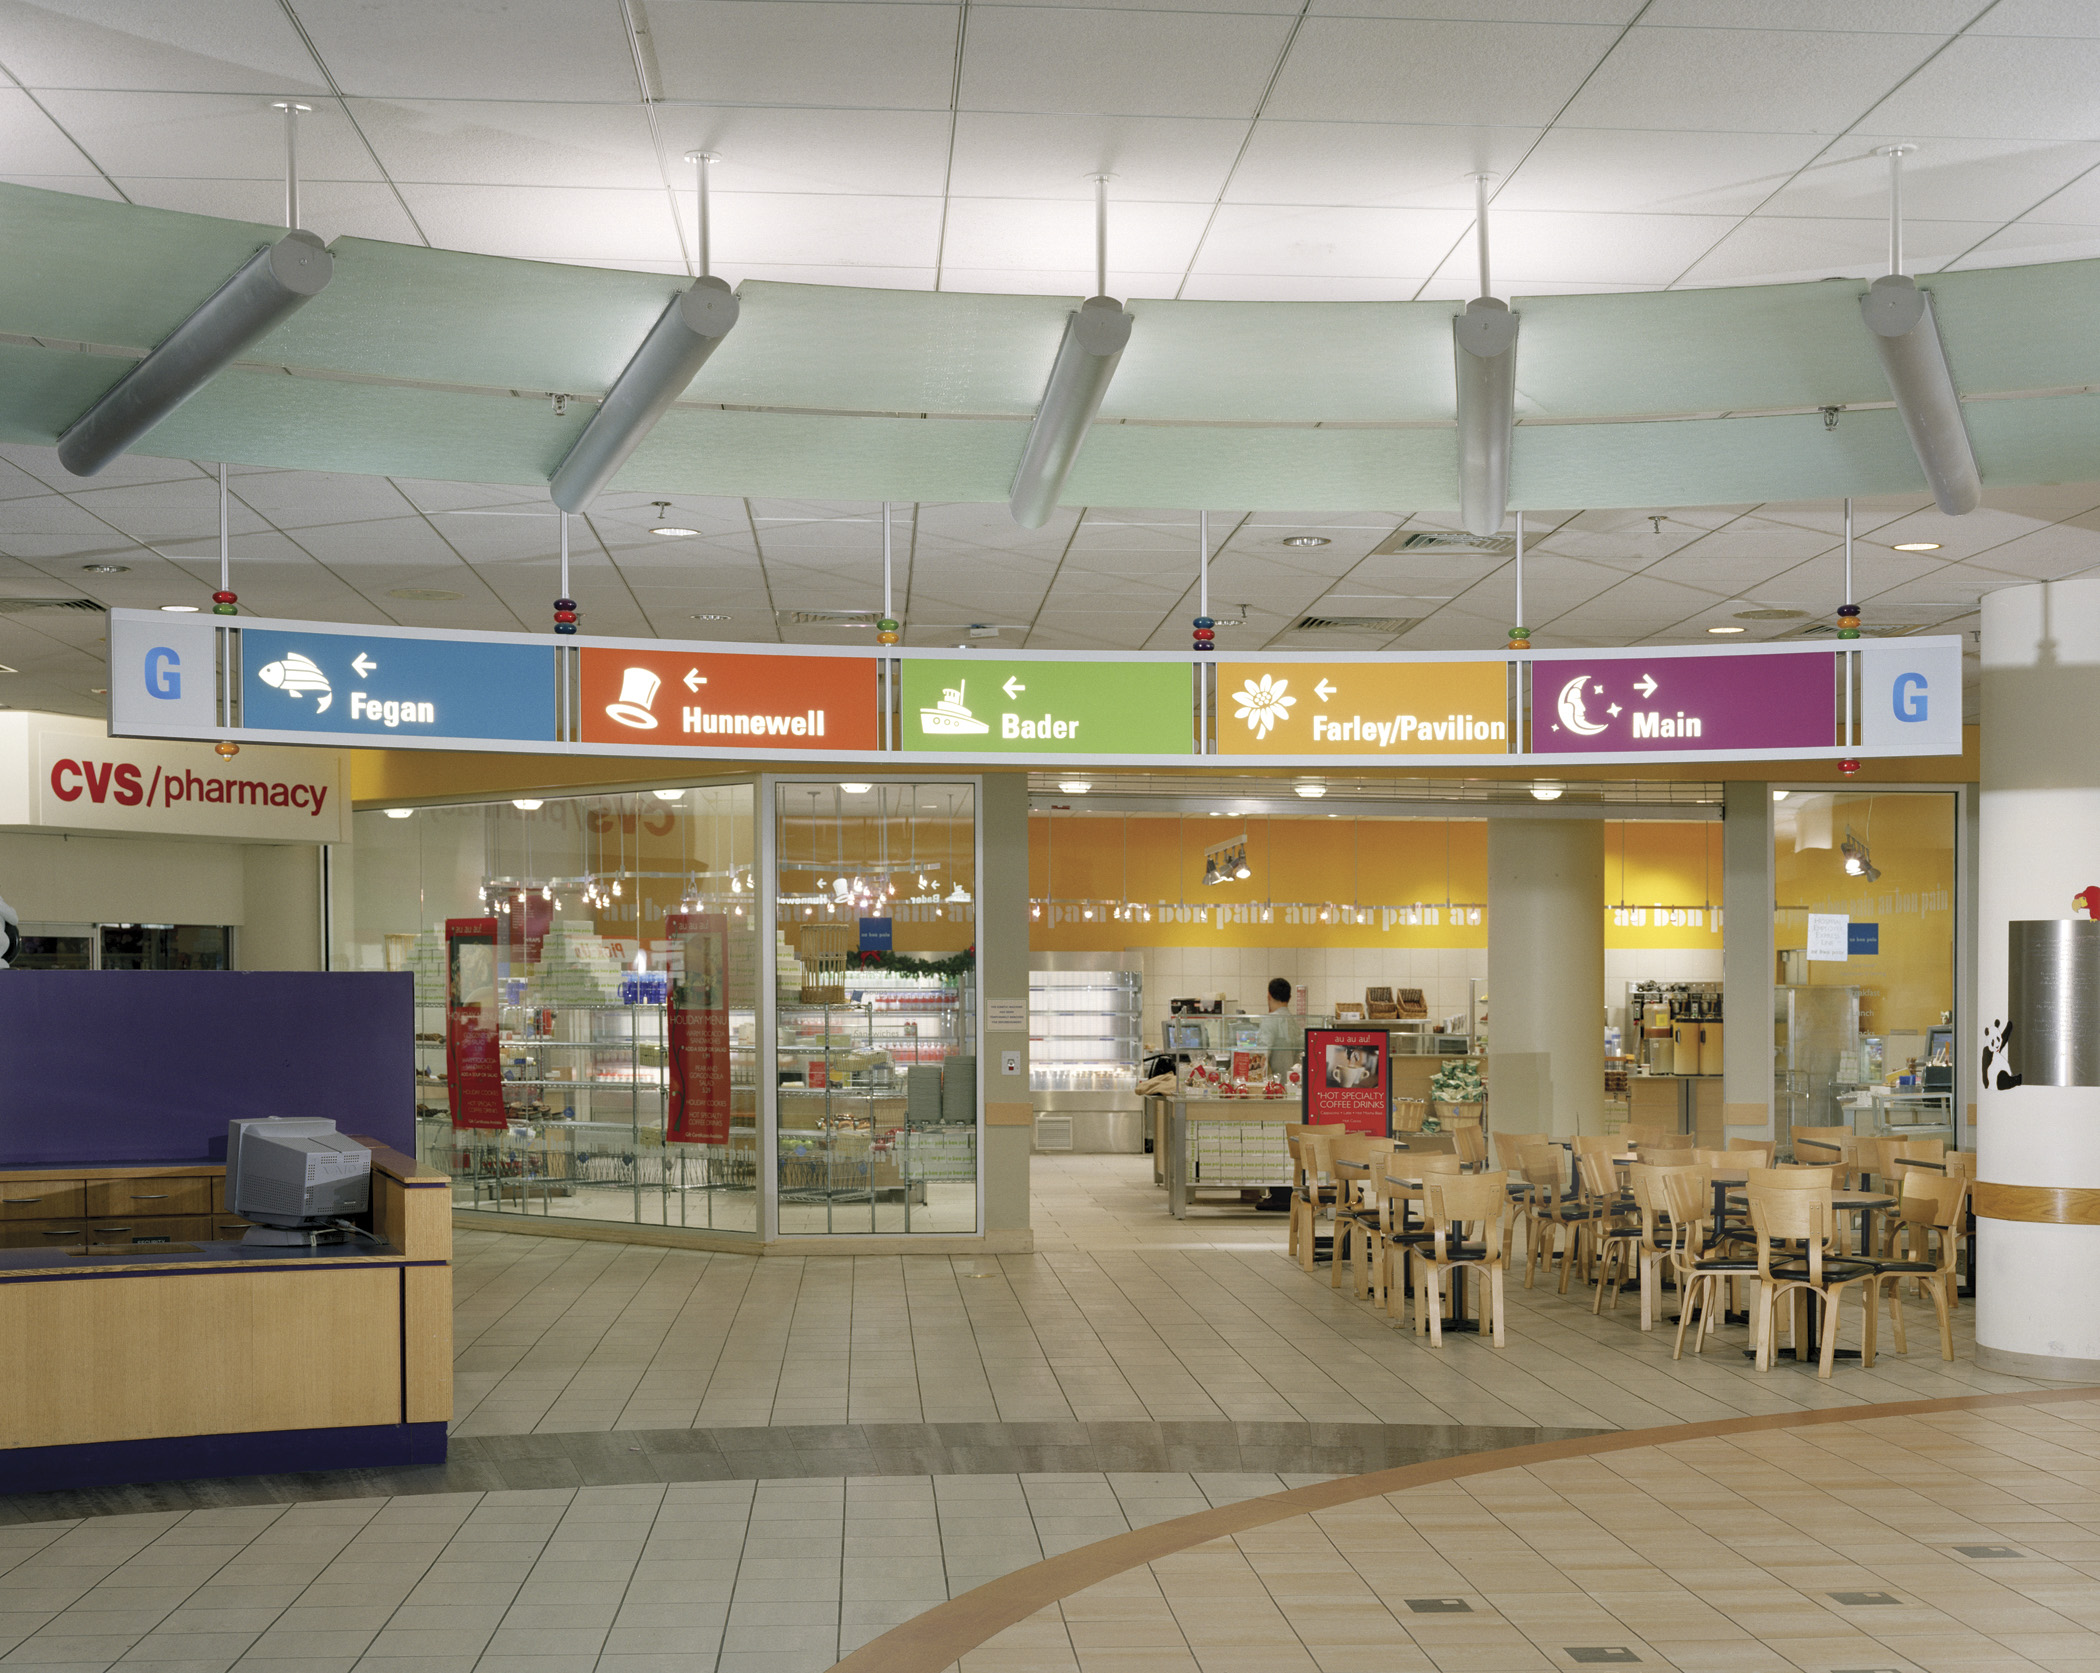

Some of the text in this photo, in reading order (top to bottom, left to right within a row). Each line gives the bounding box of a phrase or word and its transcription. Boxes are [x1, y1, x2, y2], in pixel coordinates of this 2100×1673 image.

[144, 646, 181, 700] G
[350, 691, 434, 728] Fegan
[1892, 672, 1929, 723] G
[683, 704, 826, 738] Hunnewell
[1002, 714, 1080, 740] Bader
[1313, 714, 1505, 748] Farley/Pavilion
[1633, 711, 1702, 738] Main
[51, 758, 327, 816] CVS/pharmacy
[1285, 907, 1317, 925] au
[1613, 908, 1647, 927] au
[1653, 902, 1703, 927] bon
[1319, 1100, 1385, 1109] COFFEE DRINKS
[1320, 1091, 1384, 1100] HOT SPECIALTY
